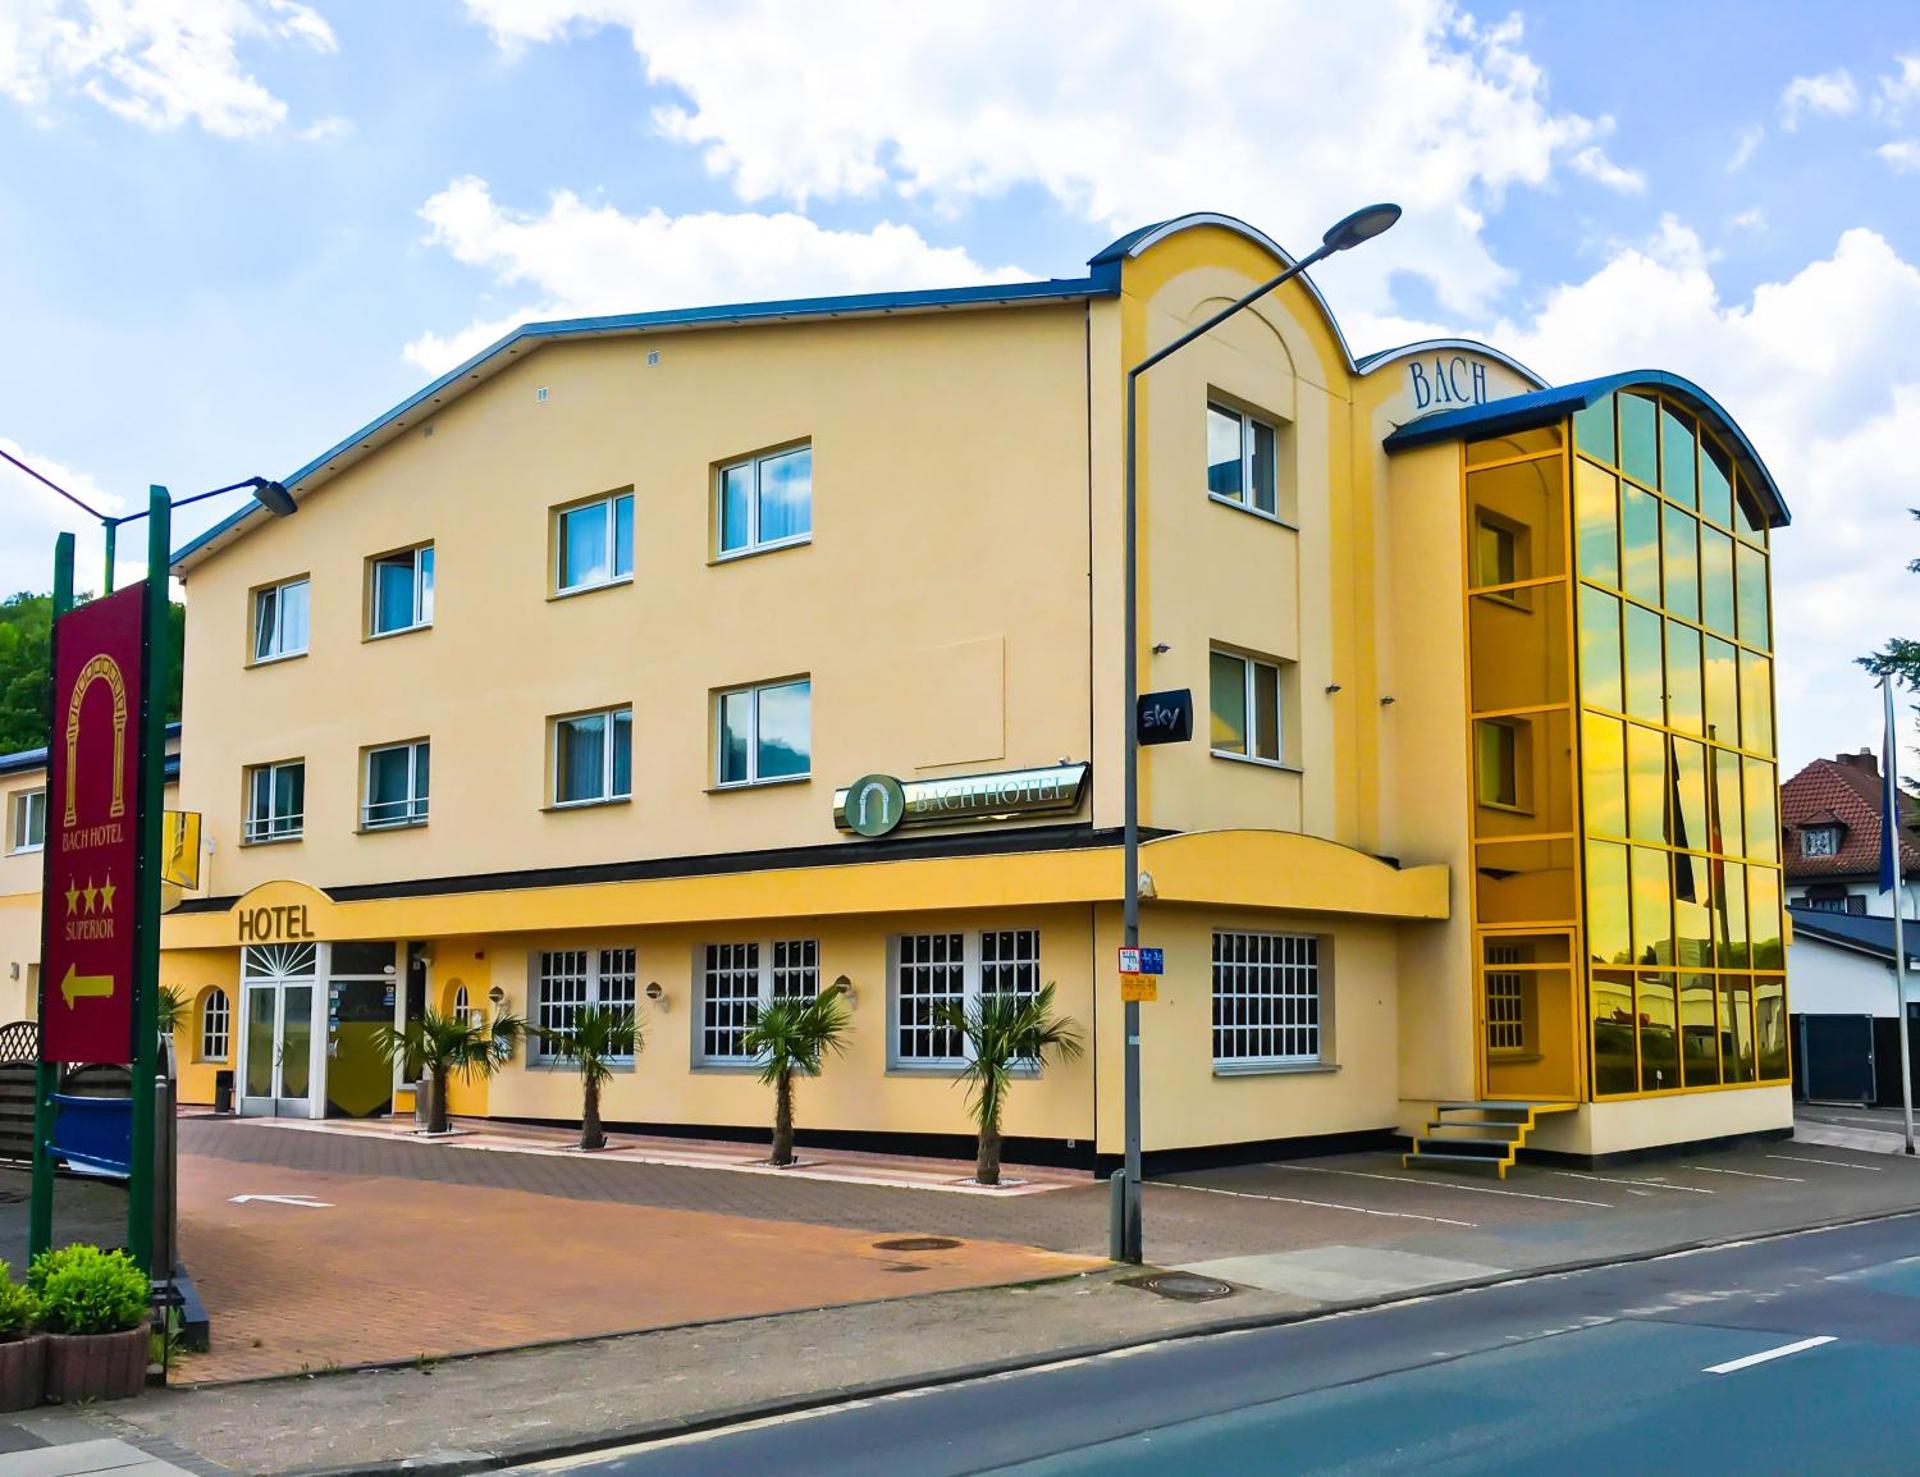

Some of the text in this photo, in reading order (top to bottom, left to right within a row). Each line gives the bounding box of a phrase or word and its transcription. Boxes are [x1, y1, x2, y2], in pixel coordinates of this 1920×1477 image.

[1408, 356, 1487, 410] BACH
[1142, 704, 1180, 731] sky
[915, 776, 1070, 813] BACH HOTEL
[62, 823, 124, 852] BACH HOTEL
[65, 918, 115, 941] SUPERIOR
[238, 904, 316, 942] HOTEL
